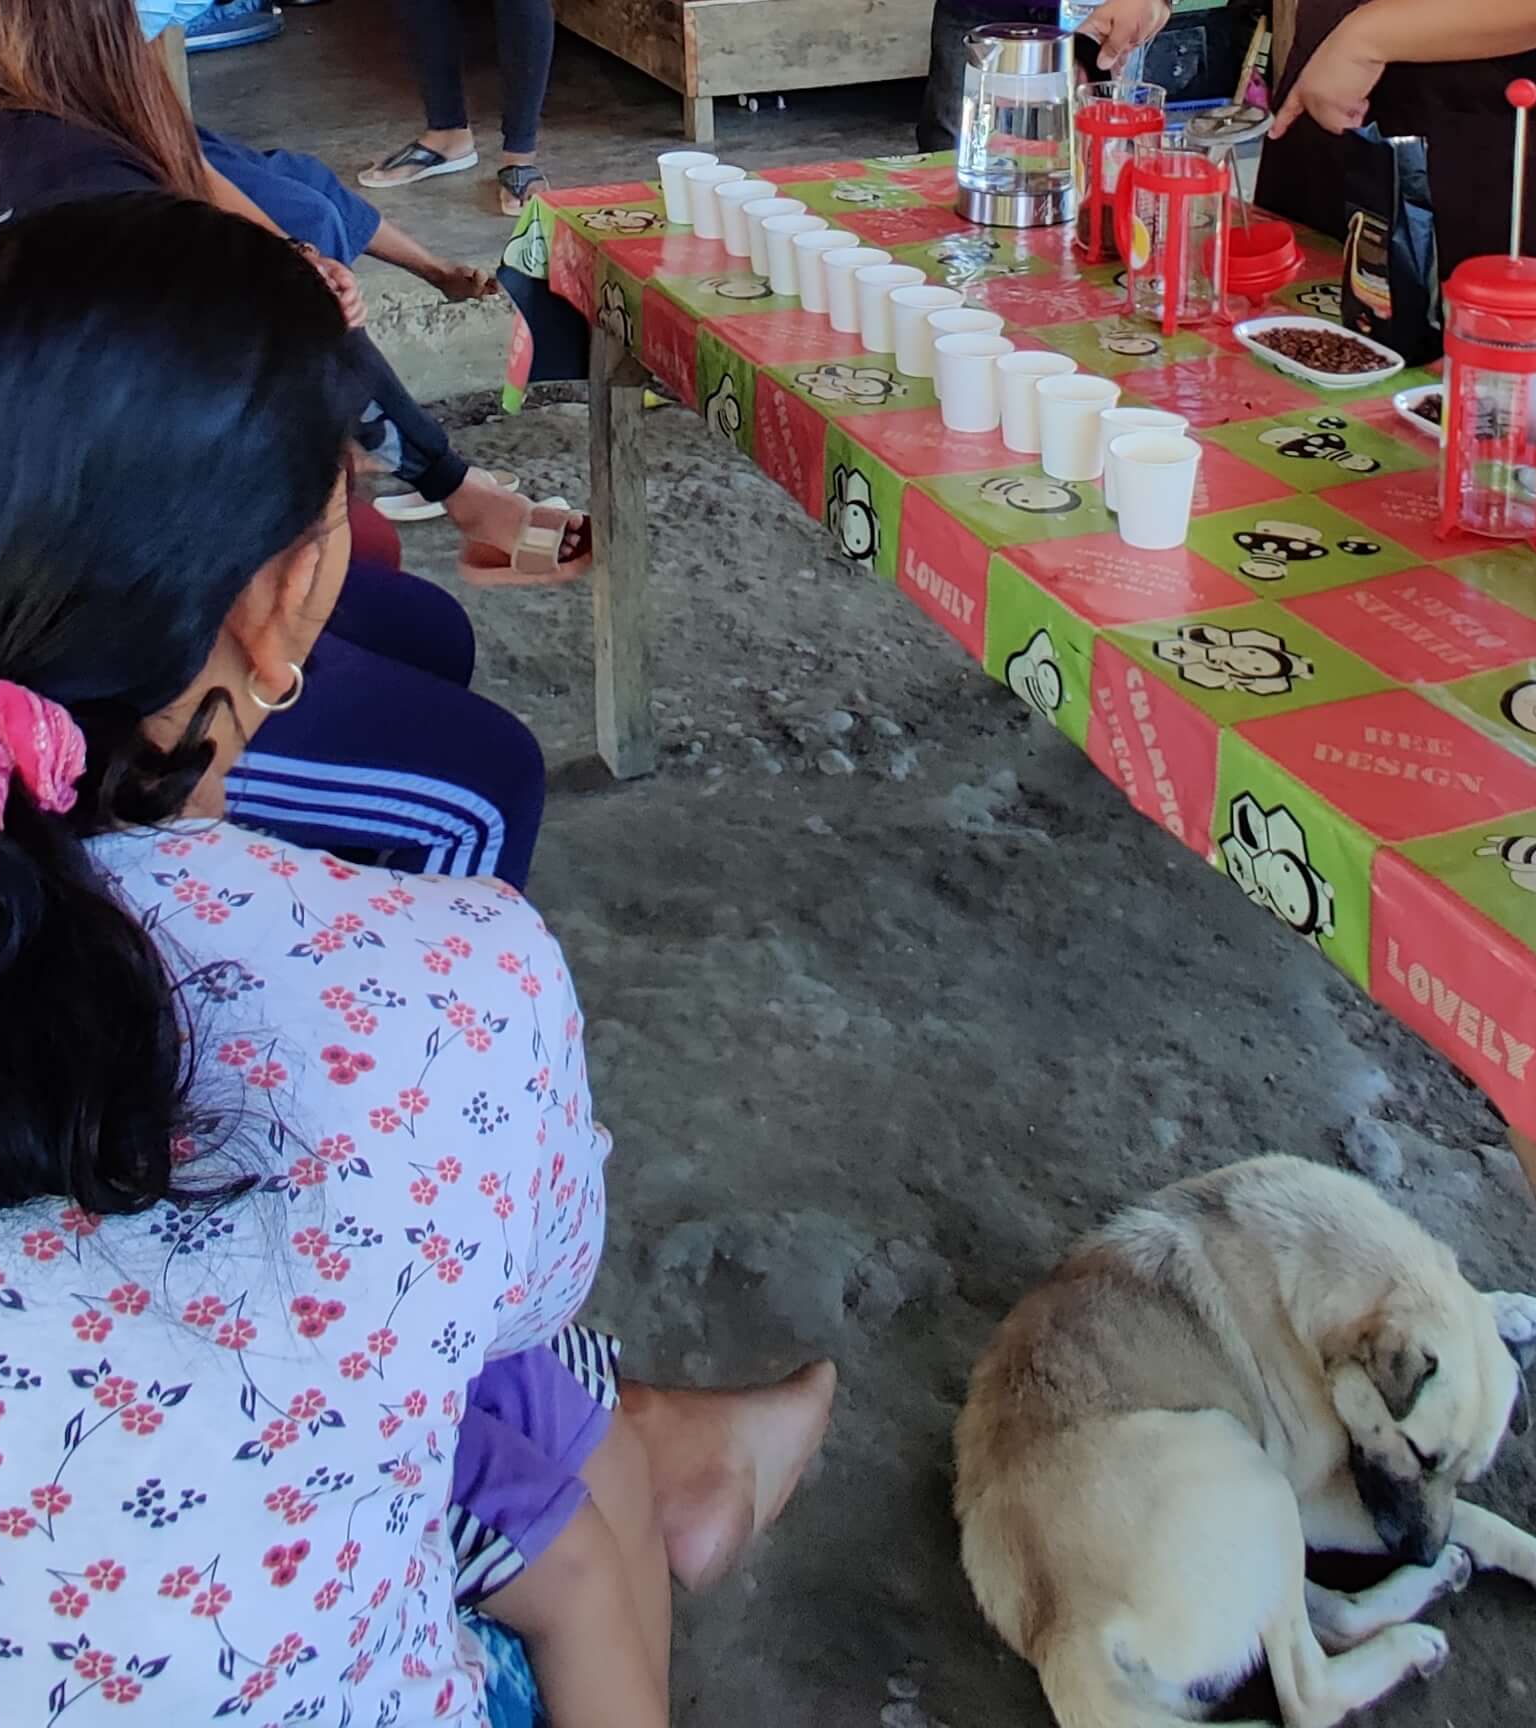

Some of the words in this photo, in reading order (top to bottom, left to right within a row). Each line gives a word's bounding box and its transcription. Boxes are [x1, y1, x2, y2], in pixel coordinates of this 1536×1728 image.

[905, 547, 976, 624] LOVELY
[1313, 742, 1484, 795] DESIGN
[1364, 725, 1454, 757] BEE
[1386, 936, 1536, 1081] LOVELY
